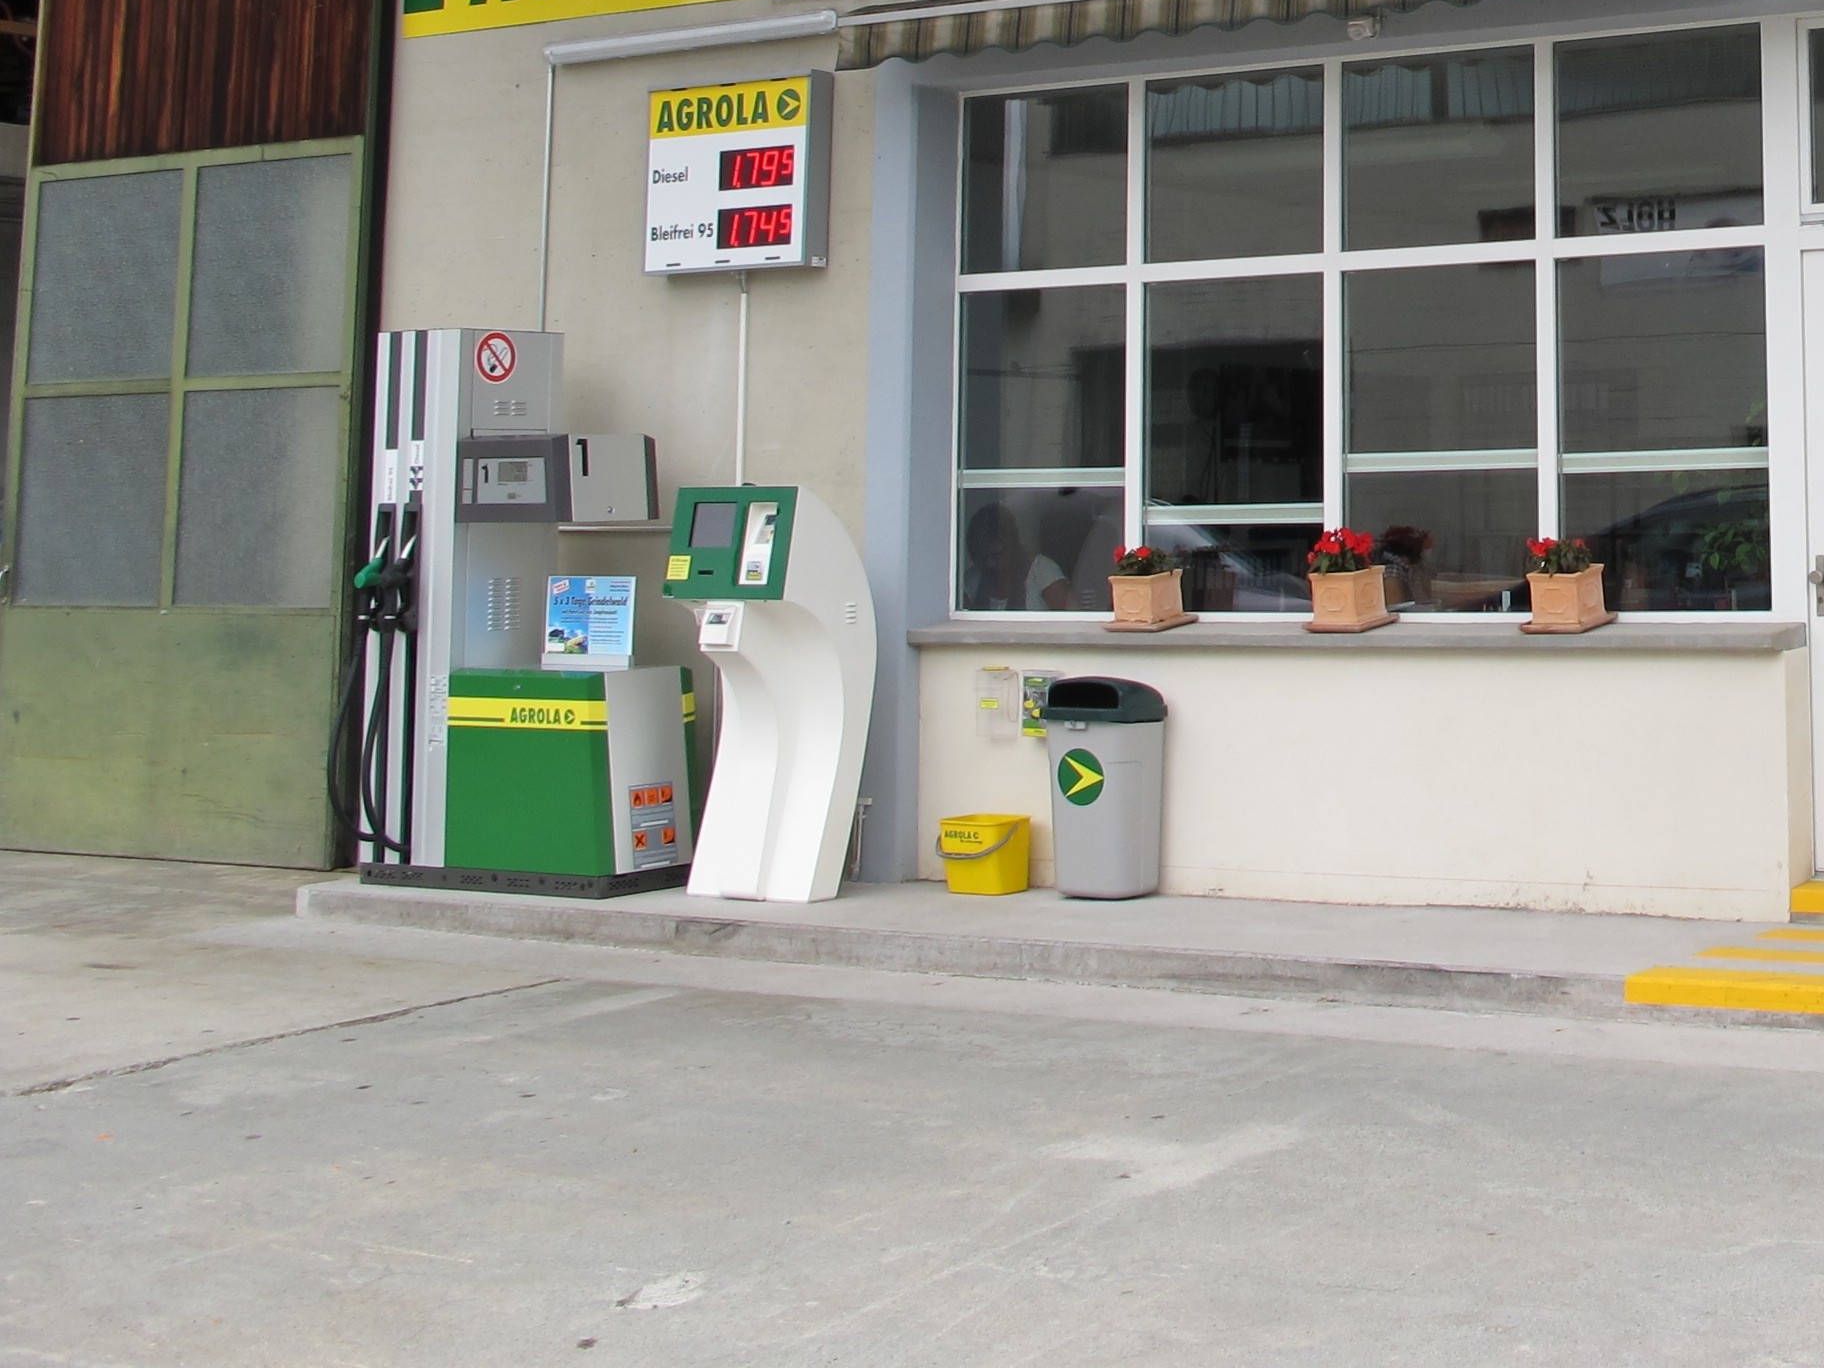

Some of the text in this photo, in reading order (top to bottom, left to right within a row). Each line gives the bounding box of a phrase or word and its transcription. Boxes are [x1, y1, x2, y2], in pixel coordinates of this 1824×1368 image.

[656, 90, 770, 133] AGROLA
[652, 166, 689, 184] Diesel
[650, 223, 695, 242] Bleifrei
[698, 222, 714, 238] 95
[576, 438, 589, 476] 1
[481, 463, 489, 483] 1
[509, 707, 561, 724] AGROLA
